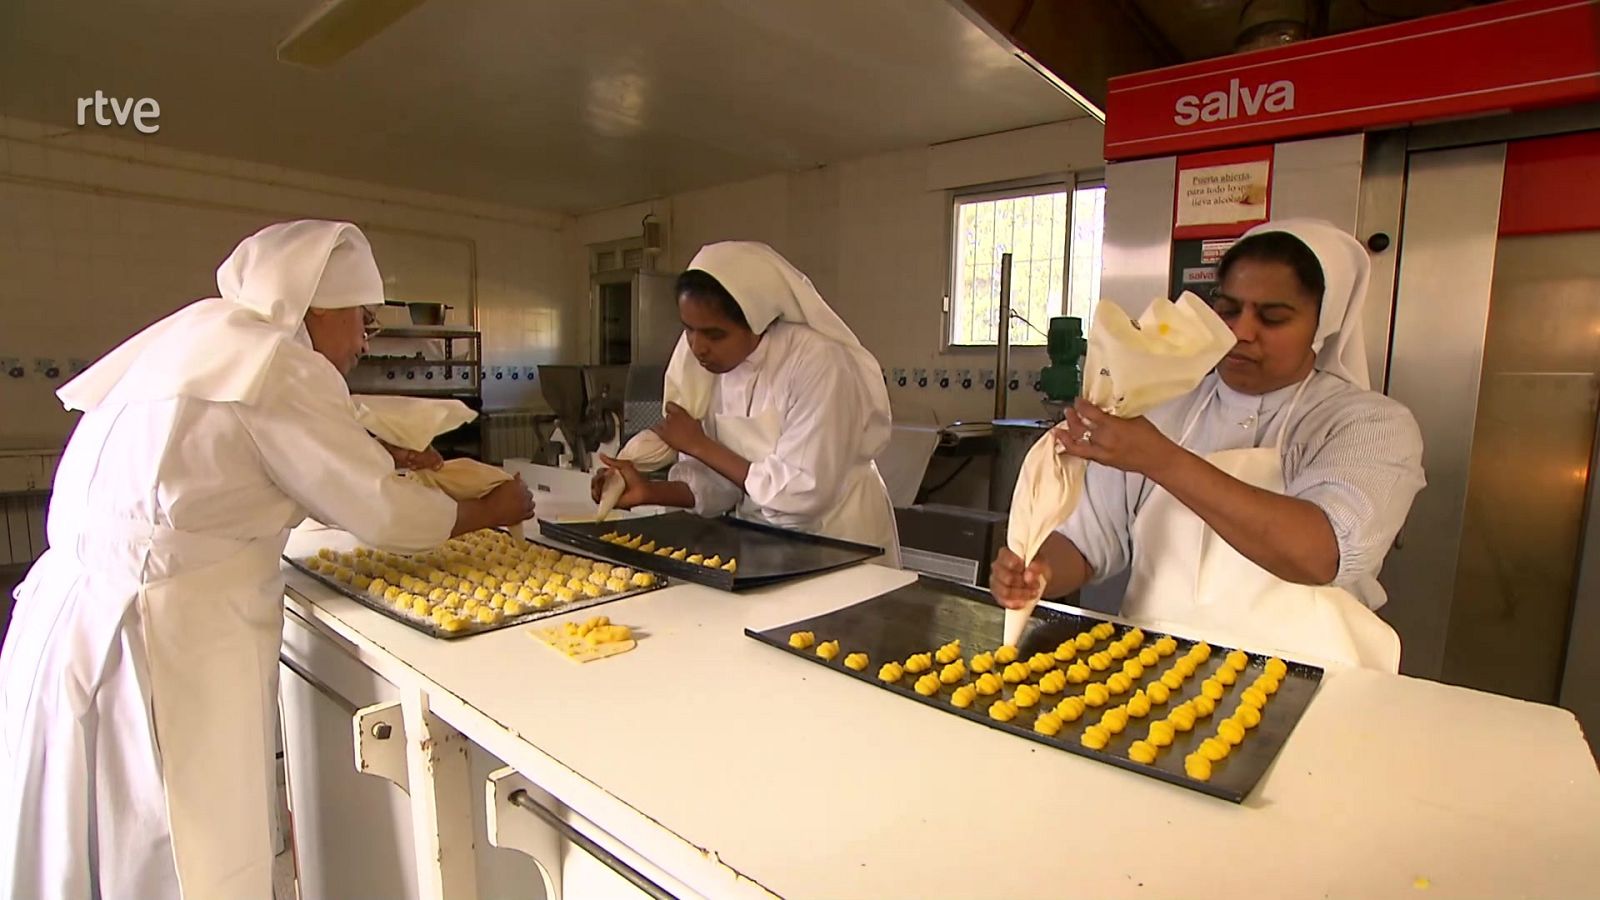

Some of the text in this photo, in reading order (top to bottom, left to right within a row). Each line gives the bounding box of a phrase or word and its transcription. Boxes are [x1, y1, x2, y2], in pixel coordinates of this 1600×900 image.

[1174, 78, 1295, 126] salva
[1187, 188, 1205, 198] para
[1206, 184, 1226, 194] todo
[1227, 183, 1237, 192] lo
[1191, 198, 1212, 207] lleva
[1188, 271, 1214, 280] salva
